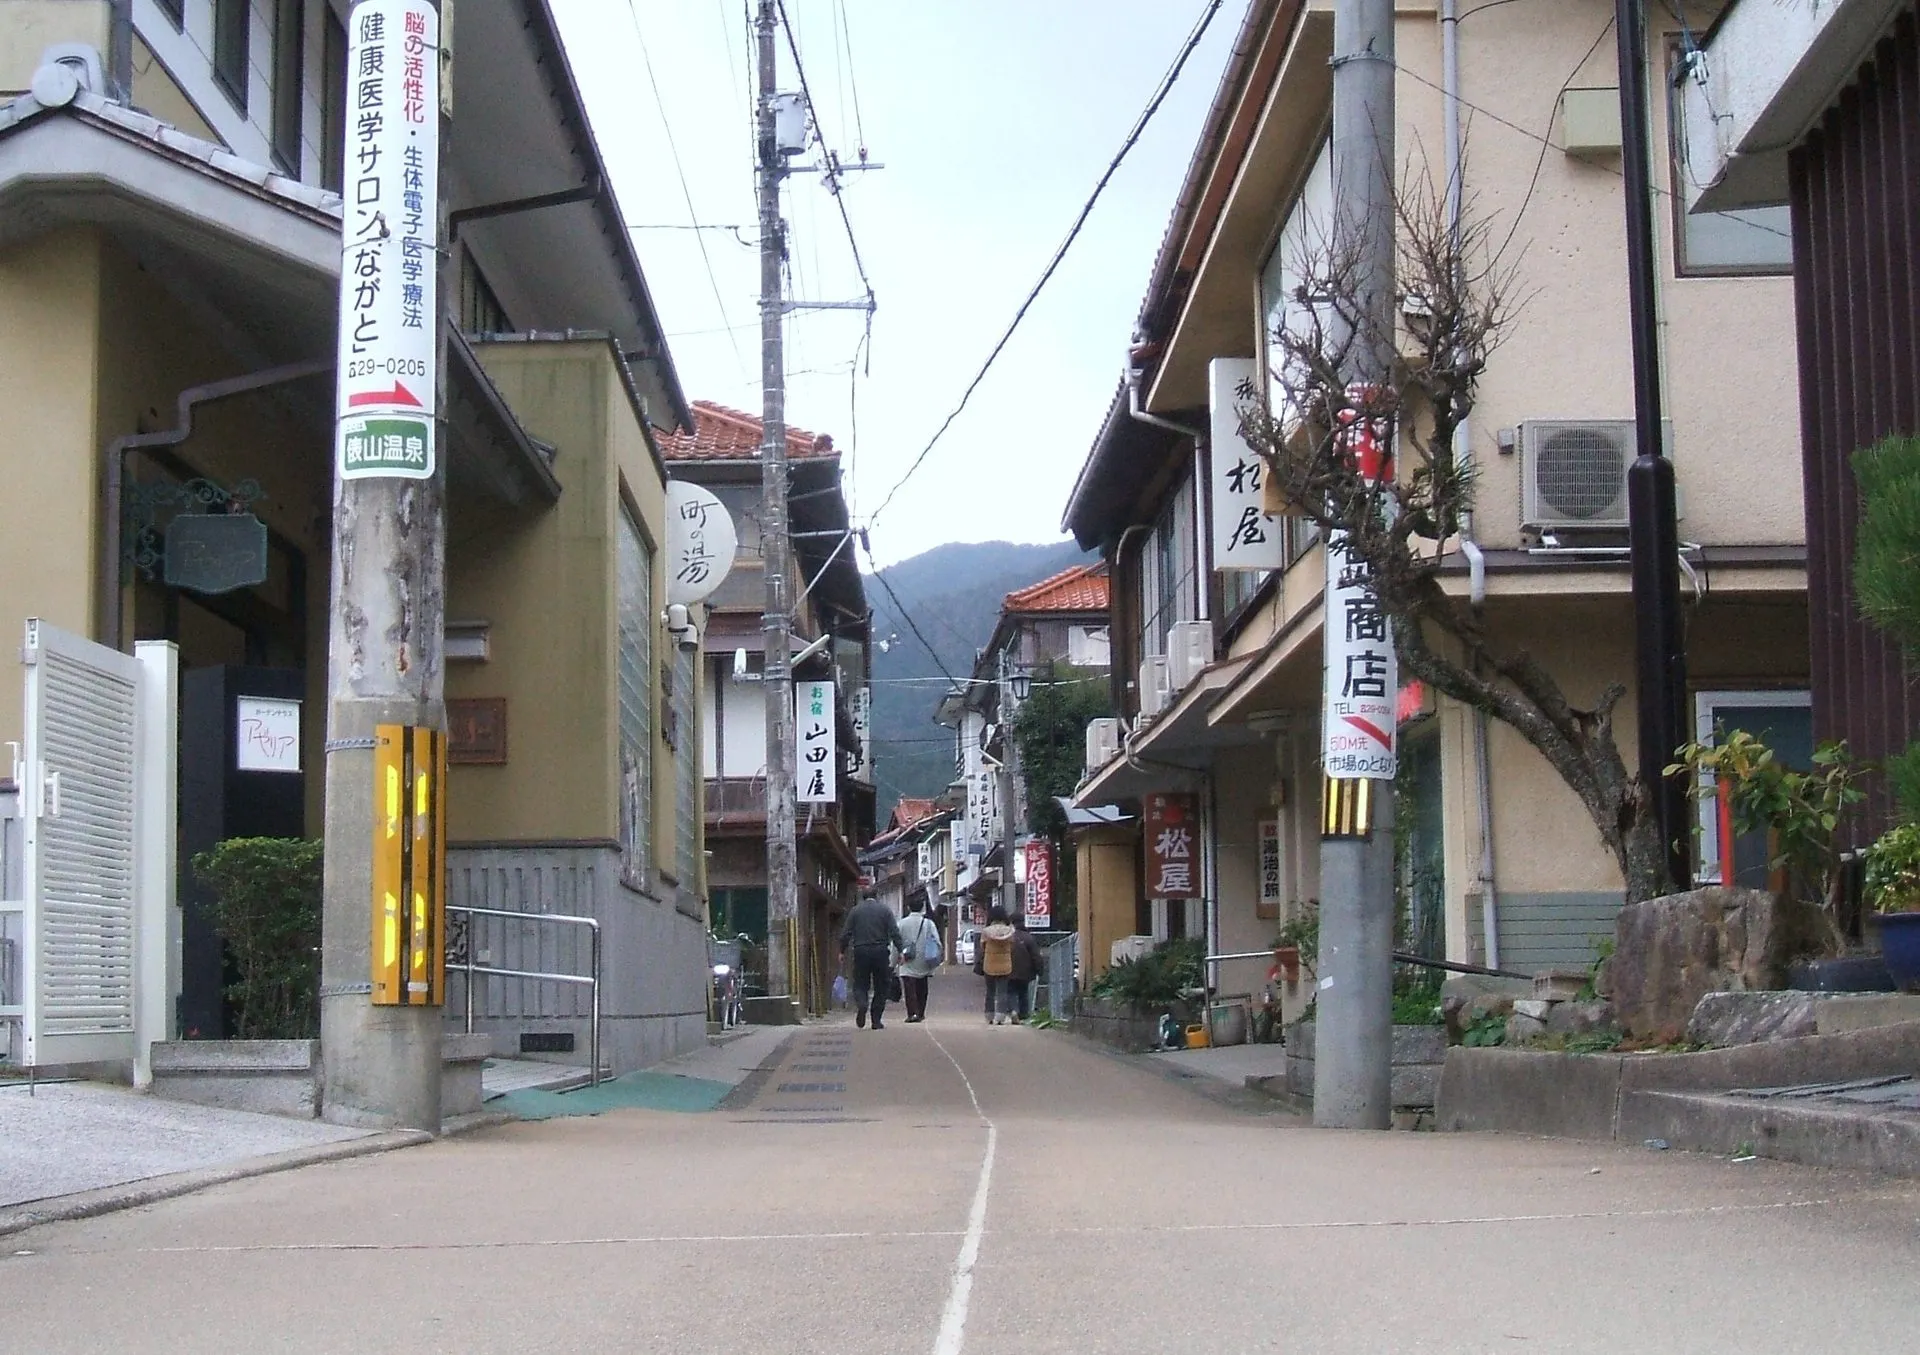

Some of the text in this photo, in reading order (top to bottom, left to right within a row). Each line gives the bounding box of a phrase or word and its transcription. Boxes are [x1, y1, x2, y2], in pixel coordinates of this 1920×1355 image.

[347, 435, 424, 464] 俵山温泉
[677, 500, 717, 583] 町の湯
[811, 686, 822, 715] お宿
[1334, 702, 1354, 715] TEL
[805, 722, 828, 796] 山田屋
[1329, 755, 1394, 773] 市場のとなり
[1154, 827, 1192, 892] 松屋
